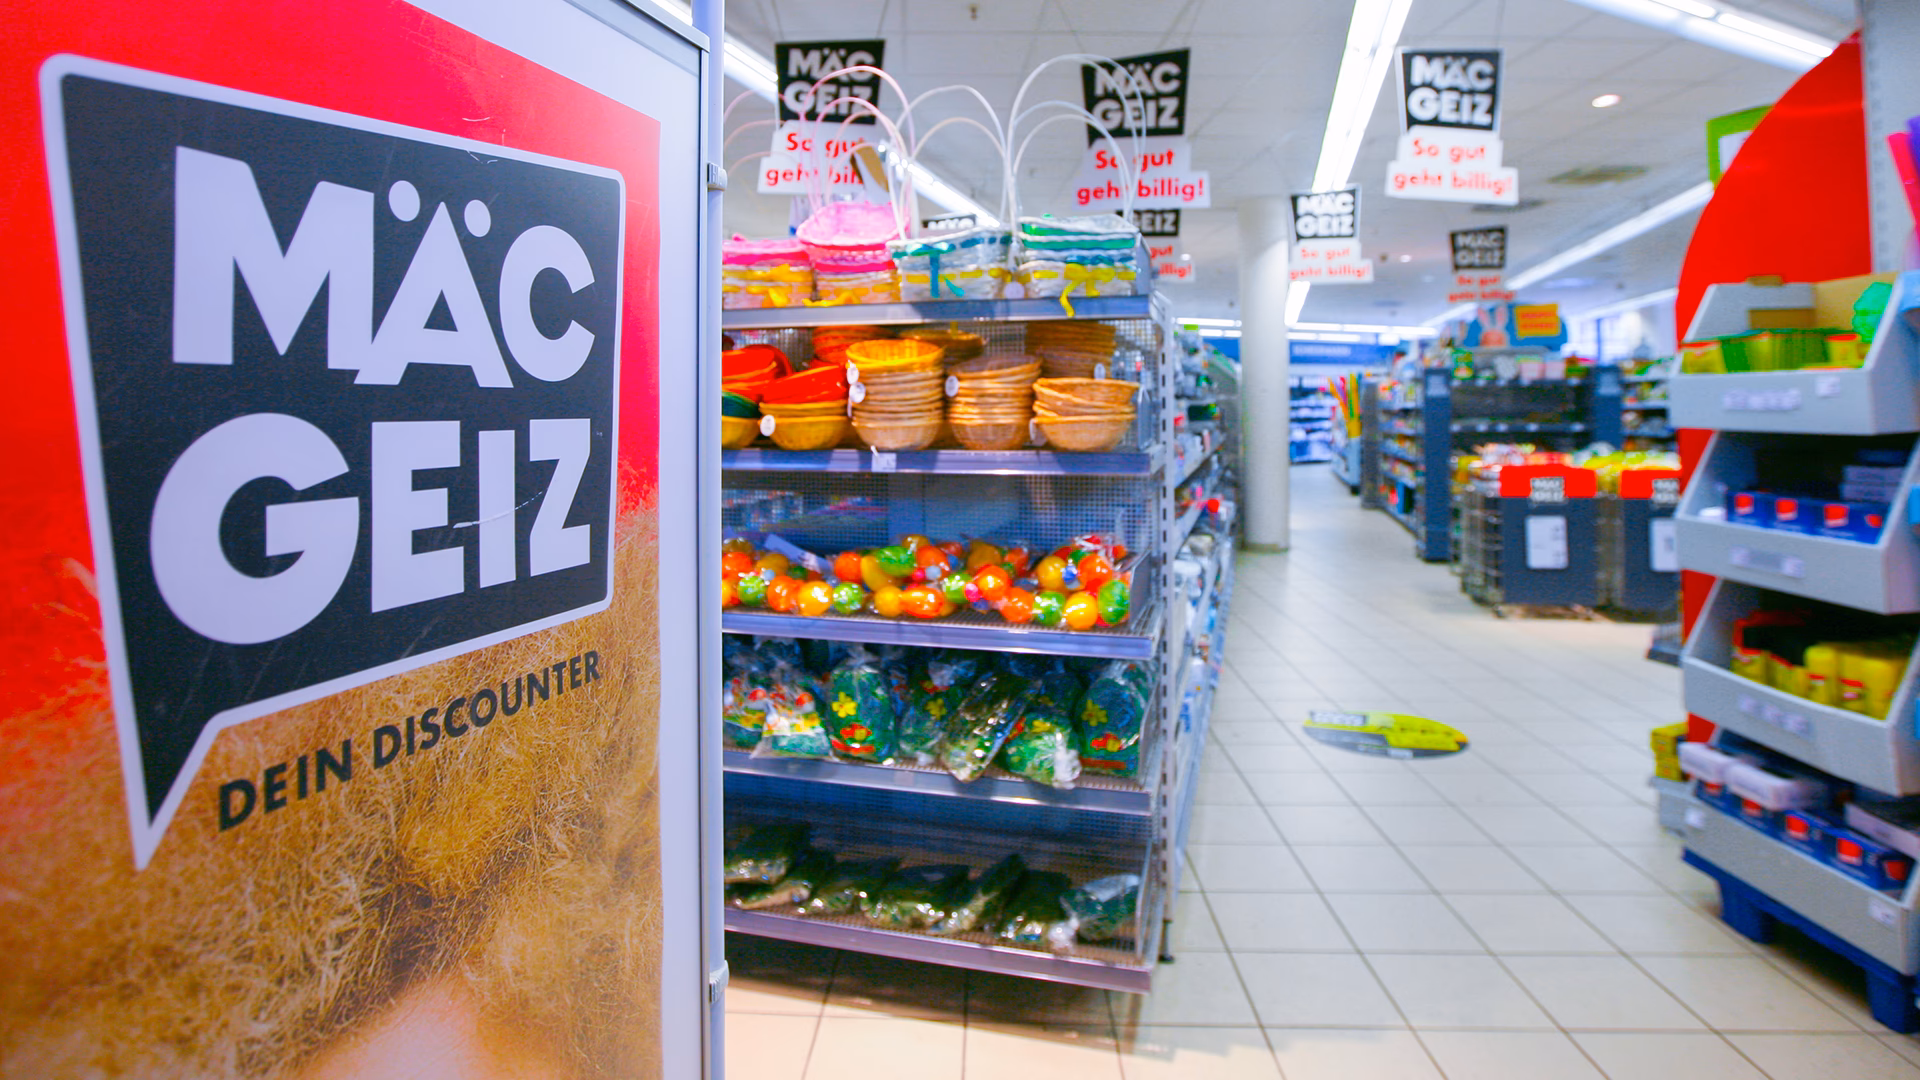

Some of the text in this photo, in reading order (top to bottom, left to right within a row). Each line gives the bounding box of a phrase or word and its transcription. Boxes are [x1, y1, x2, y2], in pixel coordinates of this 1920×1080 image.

[787, 48, 875, 82] MÄC
[1095, 61, 1181, 97] MÄC
[1410, 55, 1495, 91] MÄC
[784, 81, 873, 115] GEIZ
[1092, 97, 1180, 130] GEIZ
[1407, 87, 1493, 126] GEIZ
[1413, 137, 1486, 163] So gut
[1138, 178, 1204, 202] billig!
[1394, 168, 1513, 197] geht billig!
[172, 145, 596, 388] MÄC
[150, 412, 591, 645] GEIZ
[219, 650, 601, 832] DEIN DISCOUNTER
